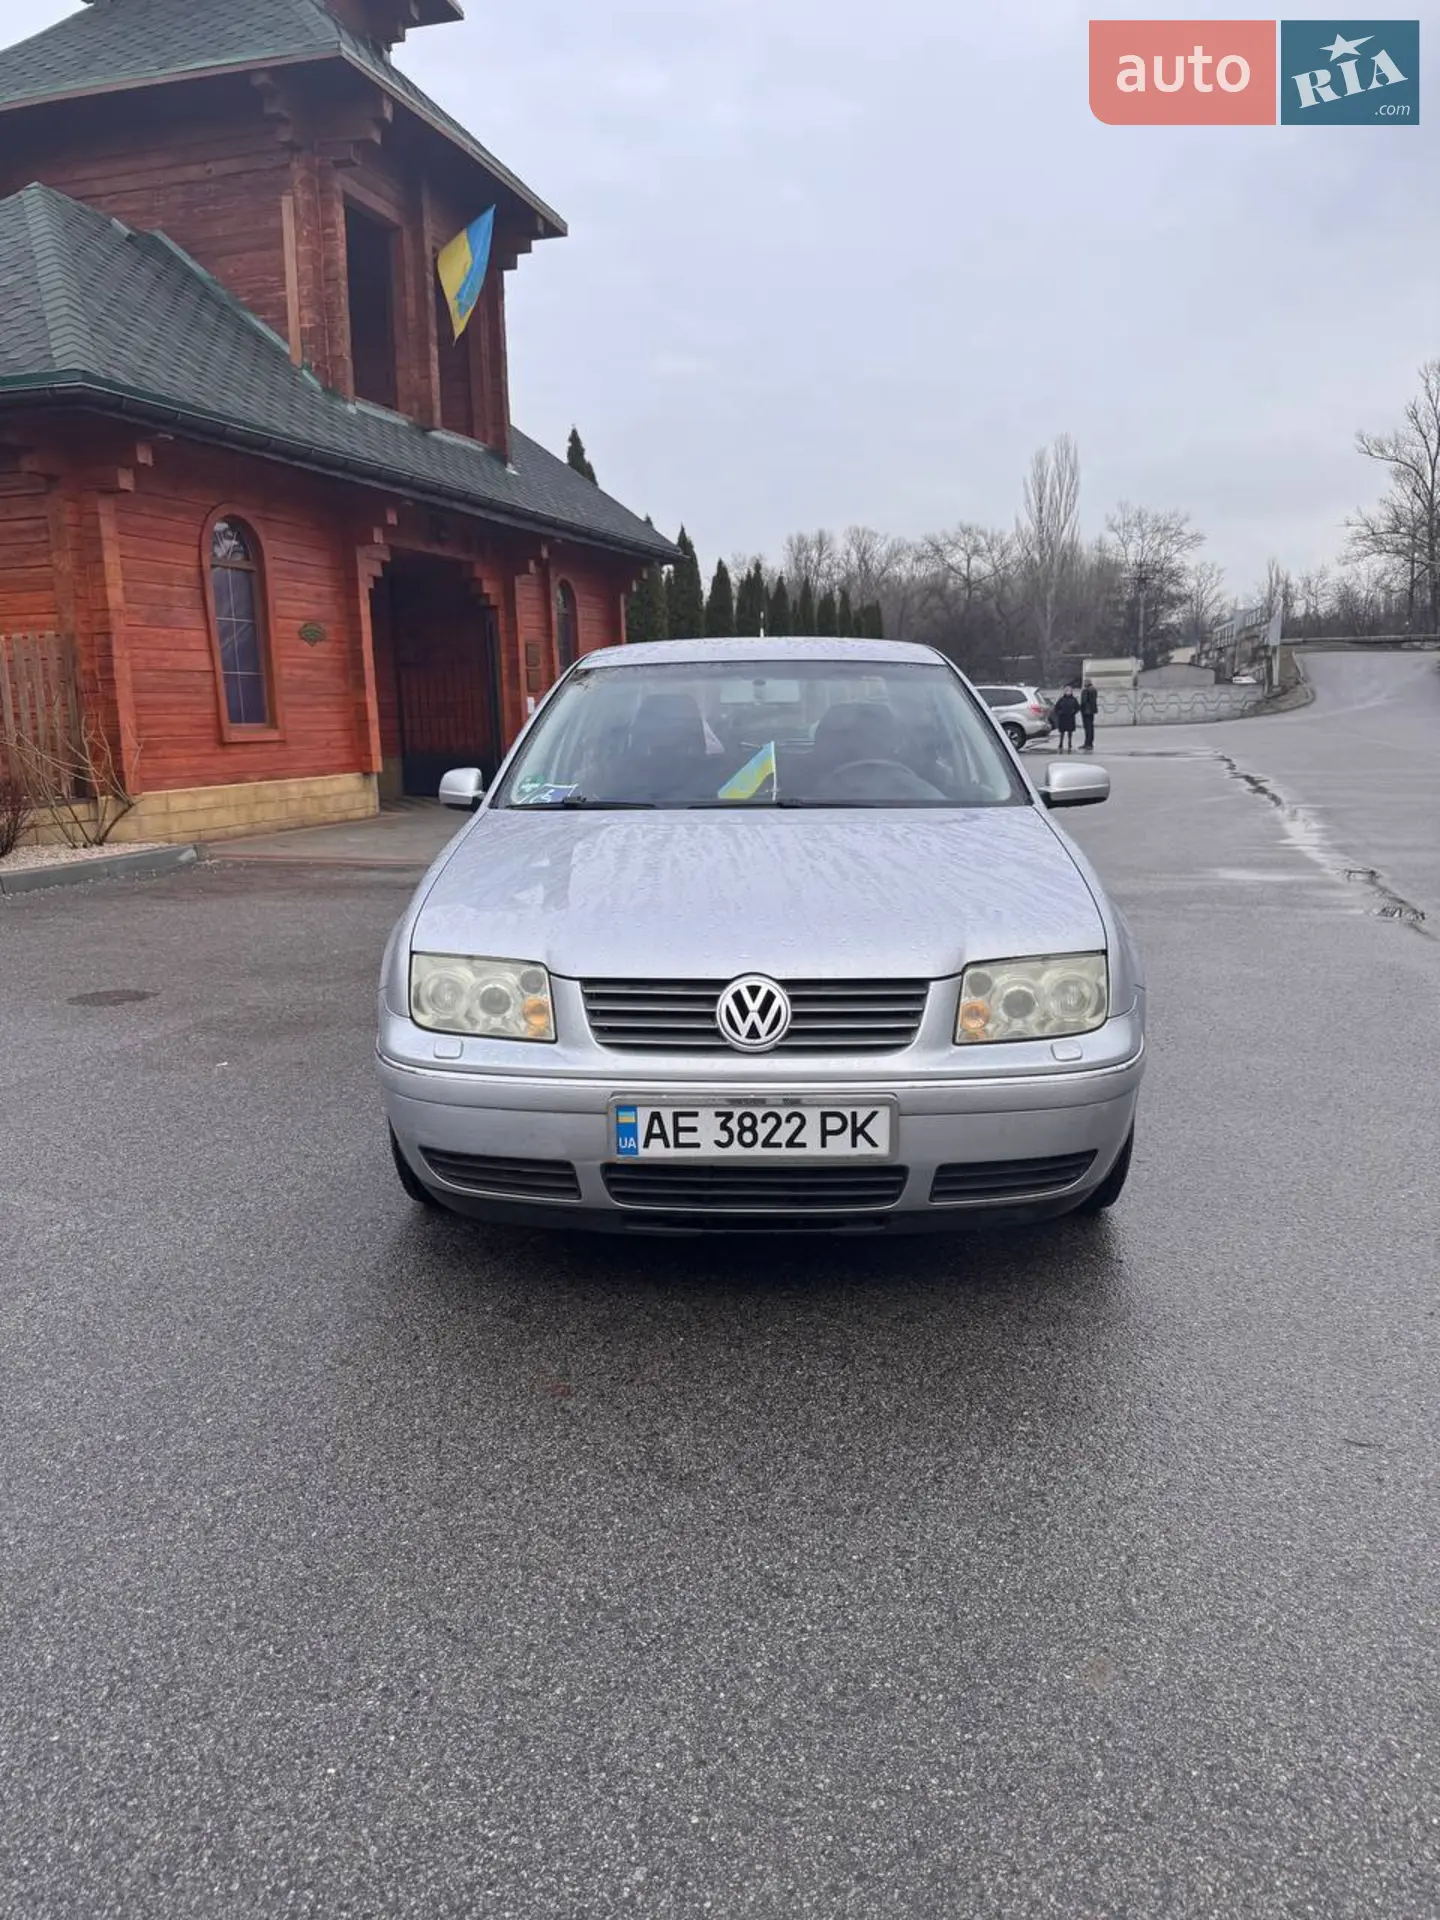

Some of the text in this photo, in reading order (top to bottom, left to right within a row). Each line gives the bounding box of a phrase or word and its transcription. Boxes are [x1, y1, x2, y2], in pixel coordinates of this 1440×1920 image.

[719, 979, 787, 1047] VW
[618, 1136, 637, 1149] UA
[642, 1110, 880, 1149] AE 3822 PK
